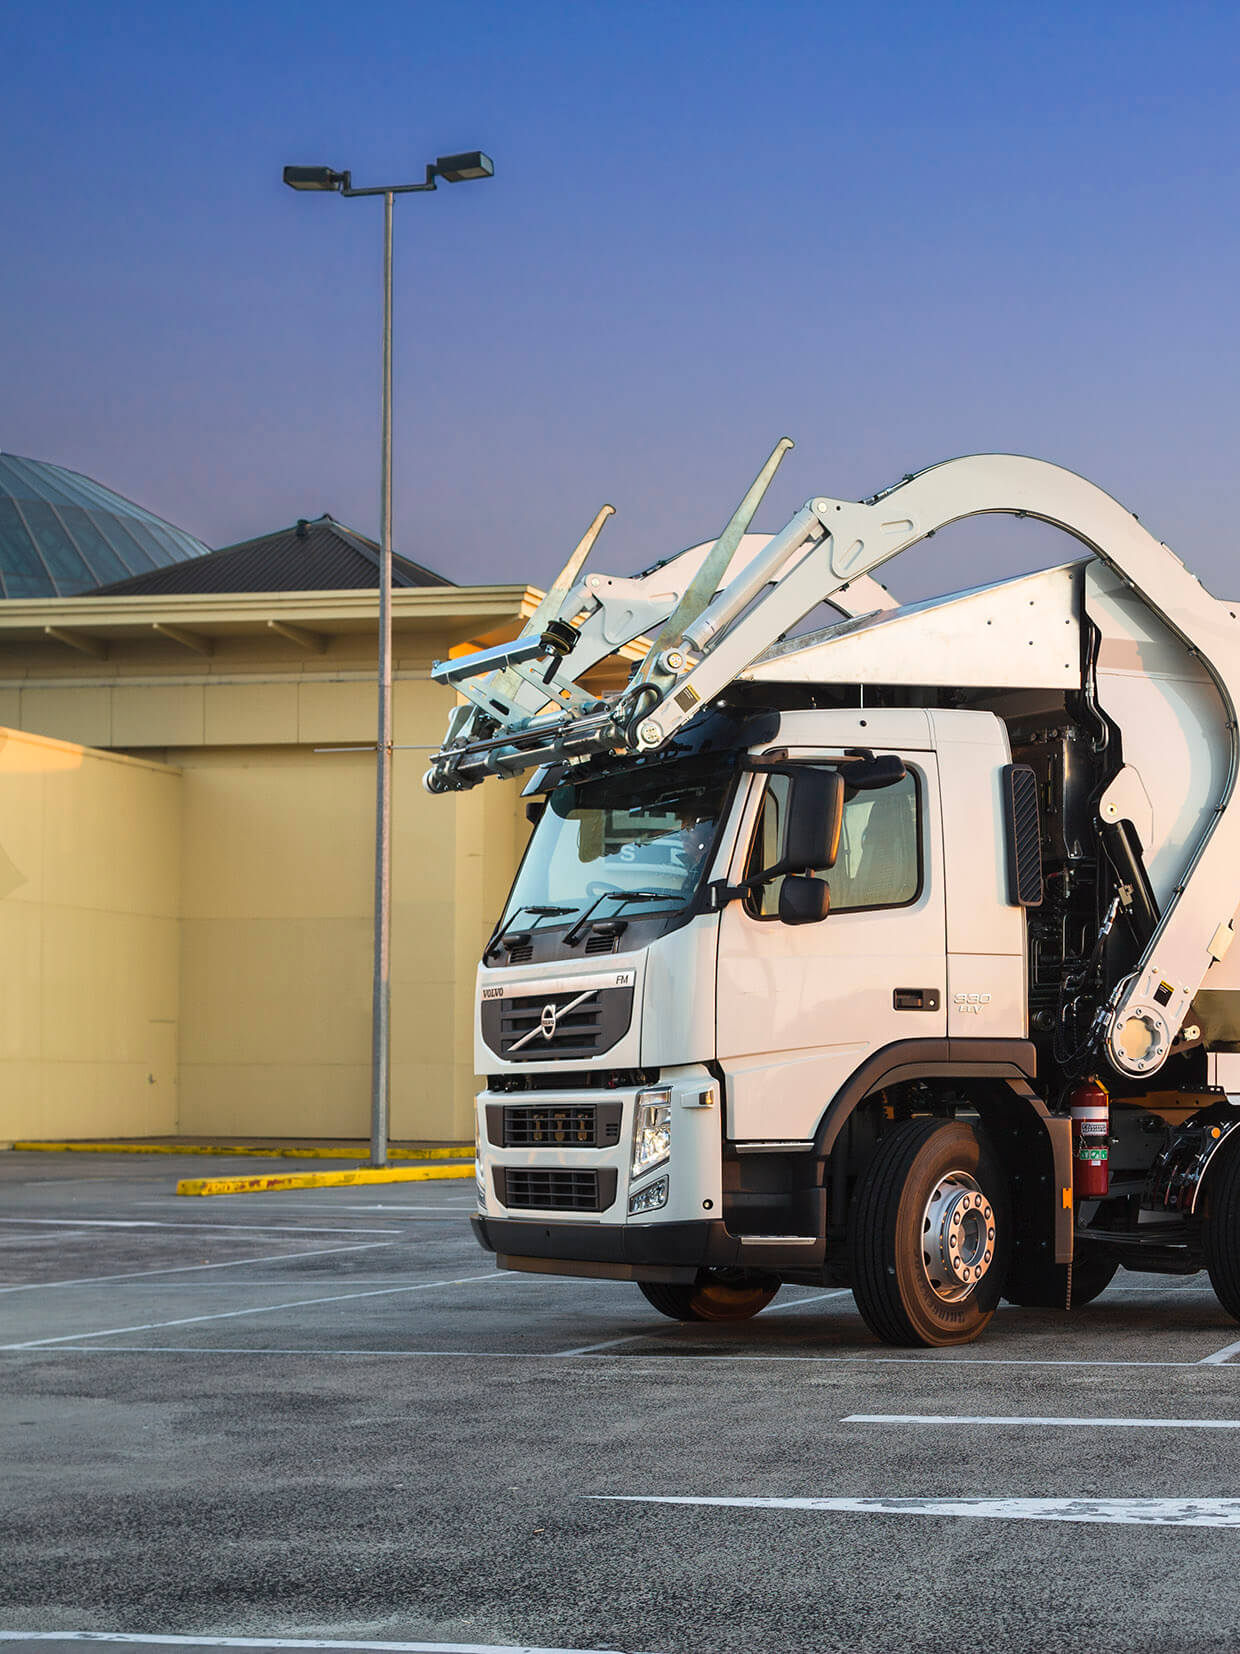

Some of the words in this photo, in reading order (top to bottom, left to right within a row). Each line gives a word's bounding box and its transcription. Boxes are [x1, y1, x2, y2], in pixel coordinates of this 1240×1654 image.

[615, 974, 629, 985] FM
[482, 987, 504, 999] VOLVO
[953, 992, 992, 1005] 330
